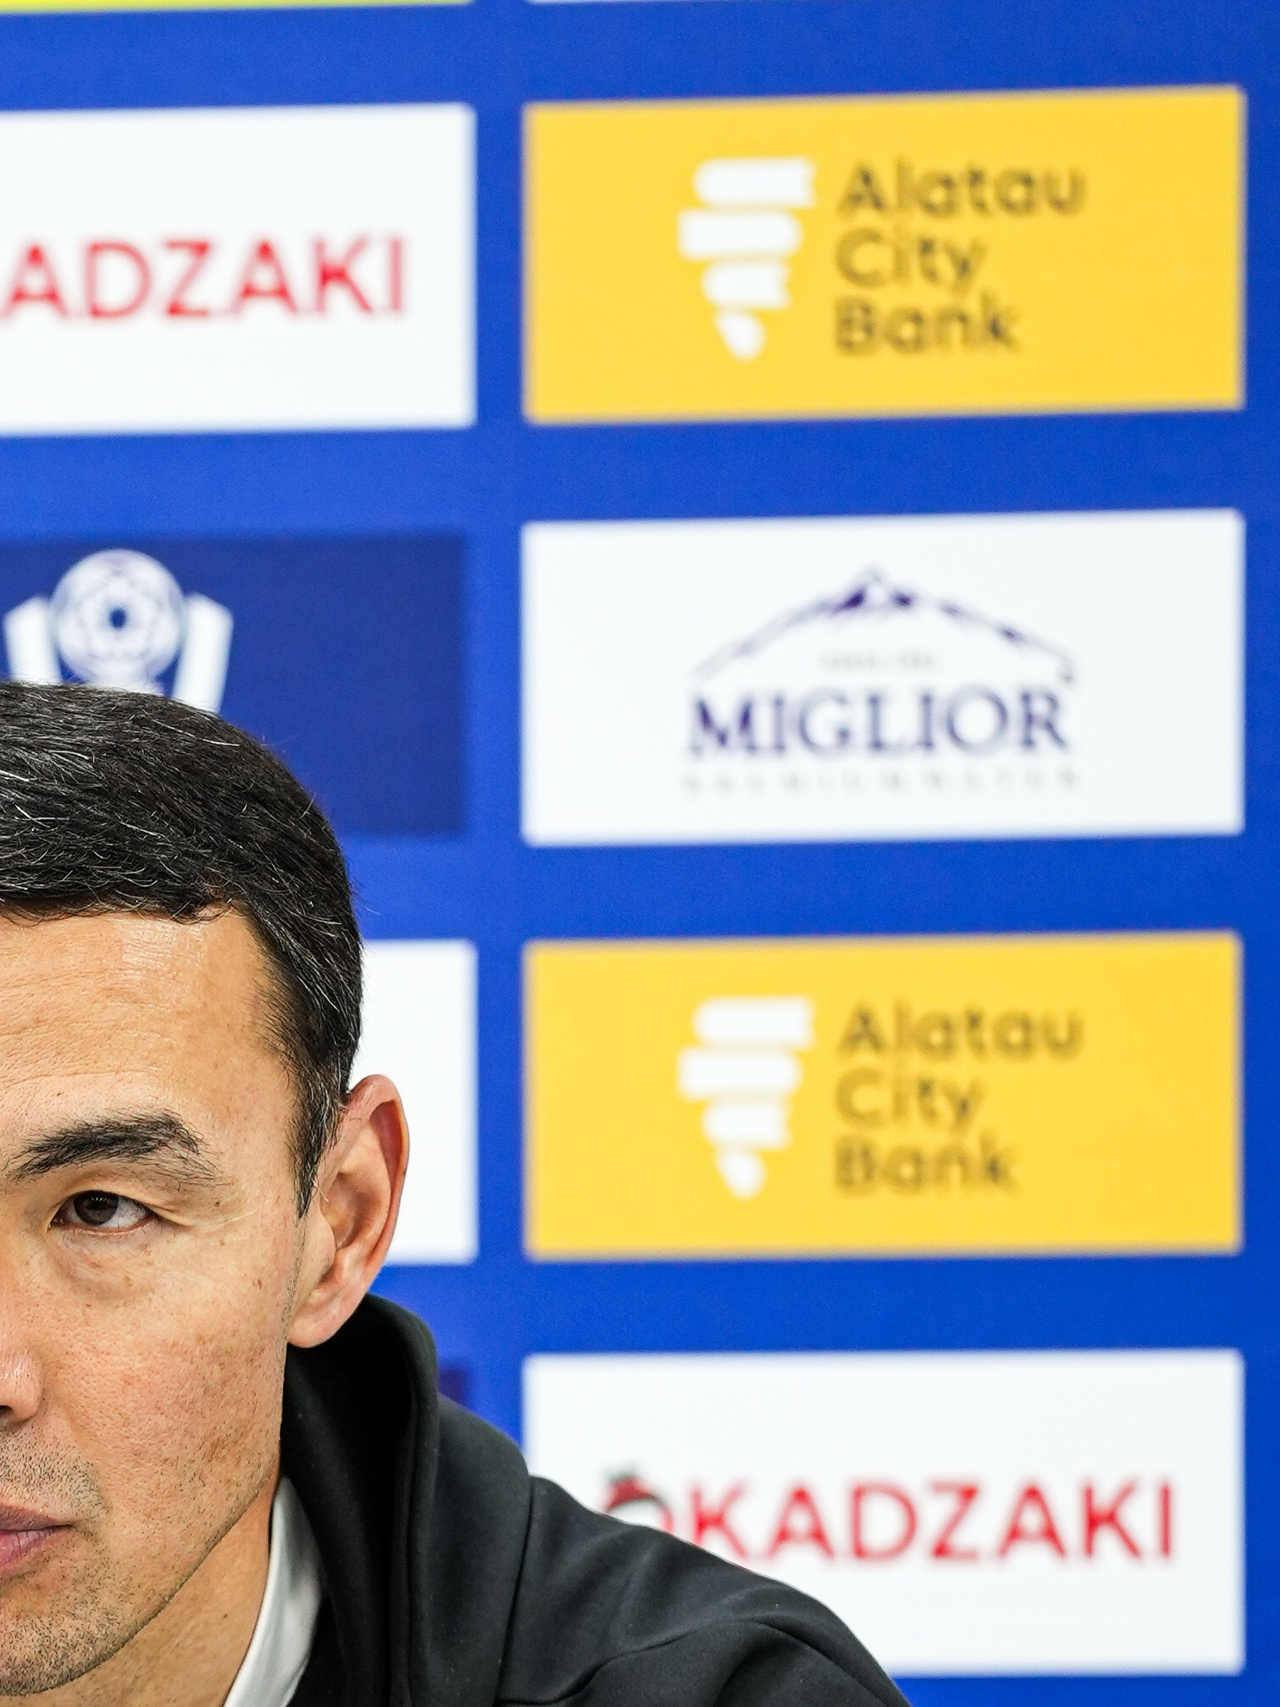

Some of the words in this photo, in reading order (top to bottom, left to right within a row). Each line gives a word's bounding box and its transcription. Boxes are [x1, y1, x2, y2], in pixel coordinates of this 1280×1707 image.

[838, 158, 1086, 217] Alatau
[834, 227, 988, 294] City
[834, 293, 1017, 357] Bank
[689, 686, 1069, 758] MIGLIOR
[838, 1001, 1084, 1061] Alatau
[834, 1068, 986, 1135] City
[834, 1134, 1016, 1195] Bank
